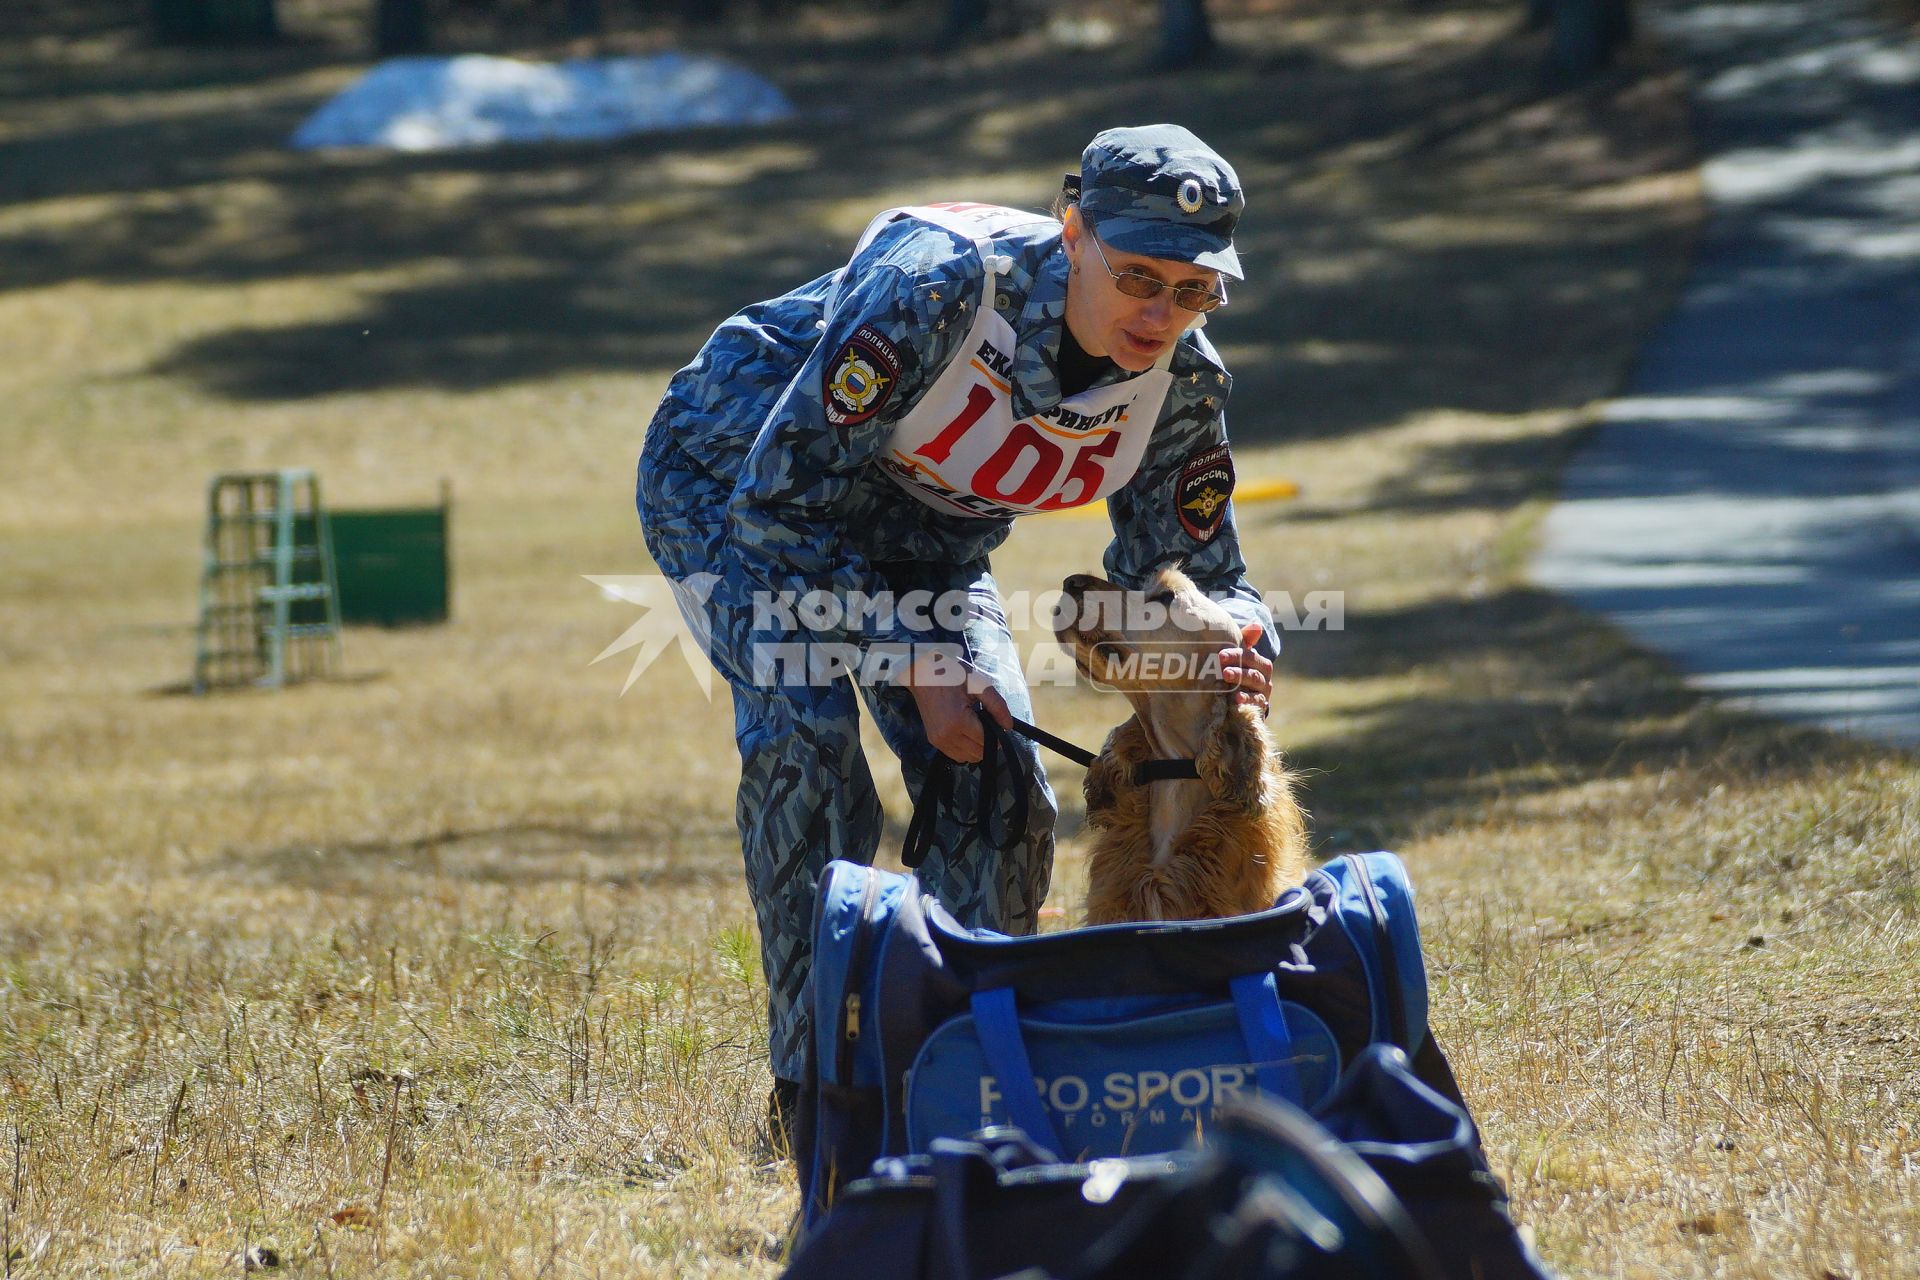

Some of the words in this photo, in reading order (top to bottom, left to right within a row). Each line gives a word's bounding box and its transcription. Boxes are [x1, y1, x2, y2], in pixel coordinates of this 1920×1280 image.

[858, 329, 899, 370] ПОЛИЦИЯ
[825, 402, 847, 424] МВД
[913, 383, 1122, 511] 105
[1189, 447, 1228, 470] ПОЛИЦИЯ
[1186, 469, 1229, 492] РОССИЯ
[1198, 526, 1214, 541] МВД
[979, 1066, 1257, 1113] PO.SPOR
